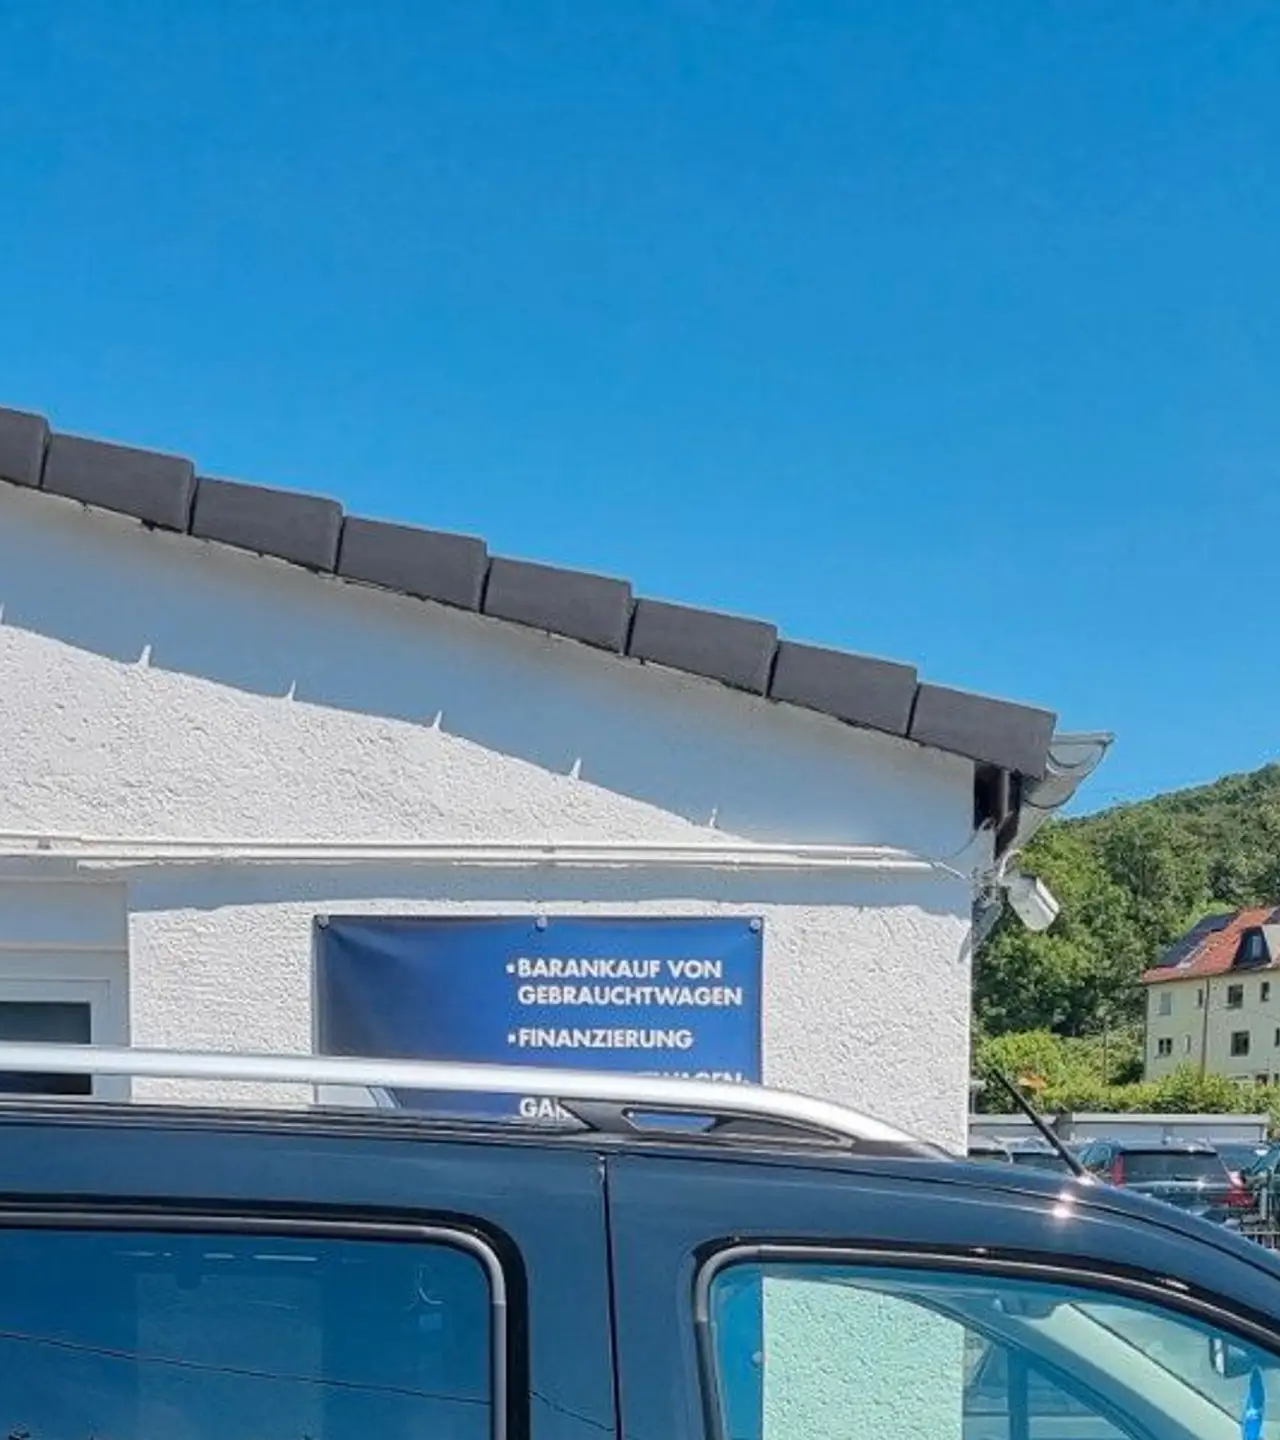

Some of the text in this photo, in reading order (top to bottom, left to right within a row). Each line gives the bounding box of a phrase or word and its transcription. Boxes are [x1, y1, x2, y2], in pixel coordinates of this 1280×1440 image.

[517, 959, 724, 979] BARANKAUF VON
[518, 986, 743, 1006] GEBRAUCHTWAGEN
[519, 1029, 694, 1049] FINANZIERUNG
